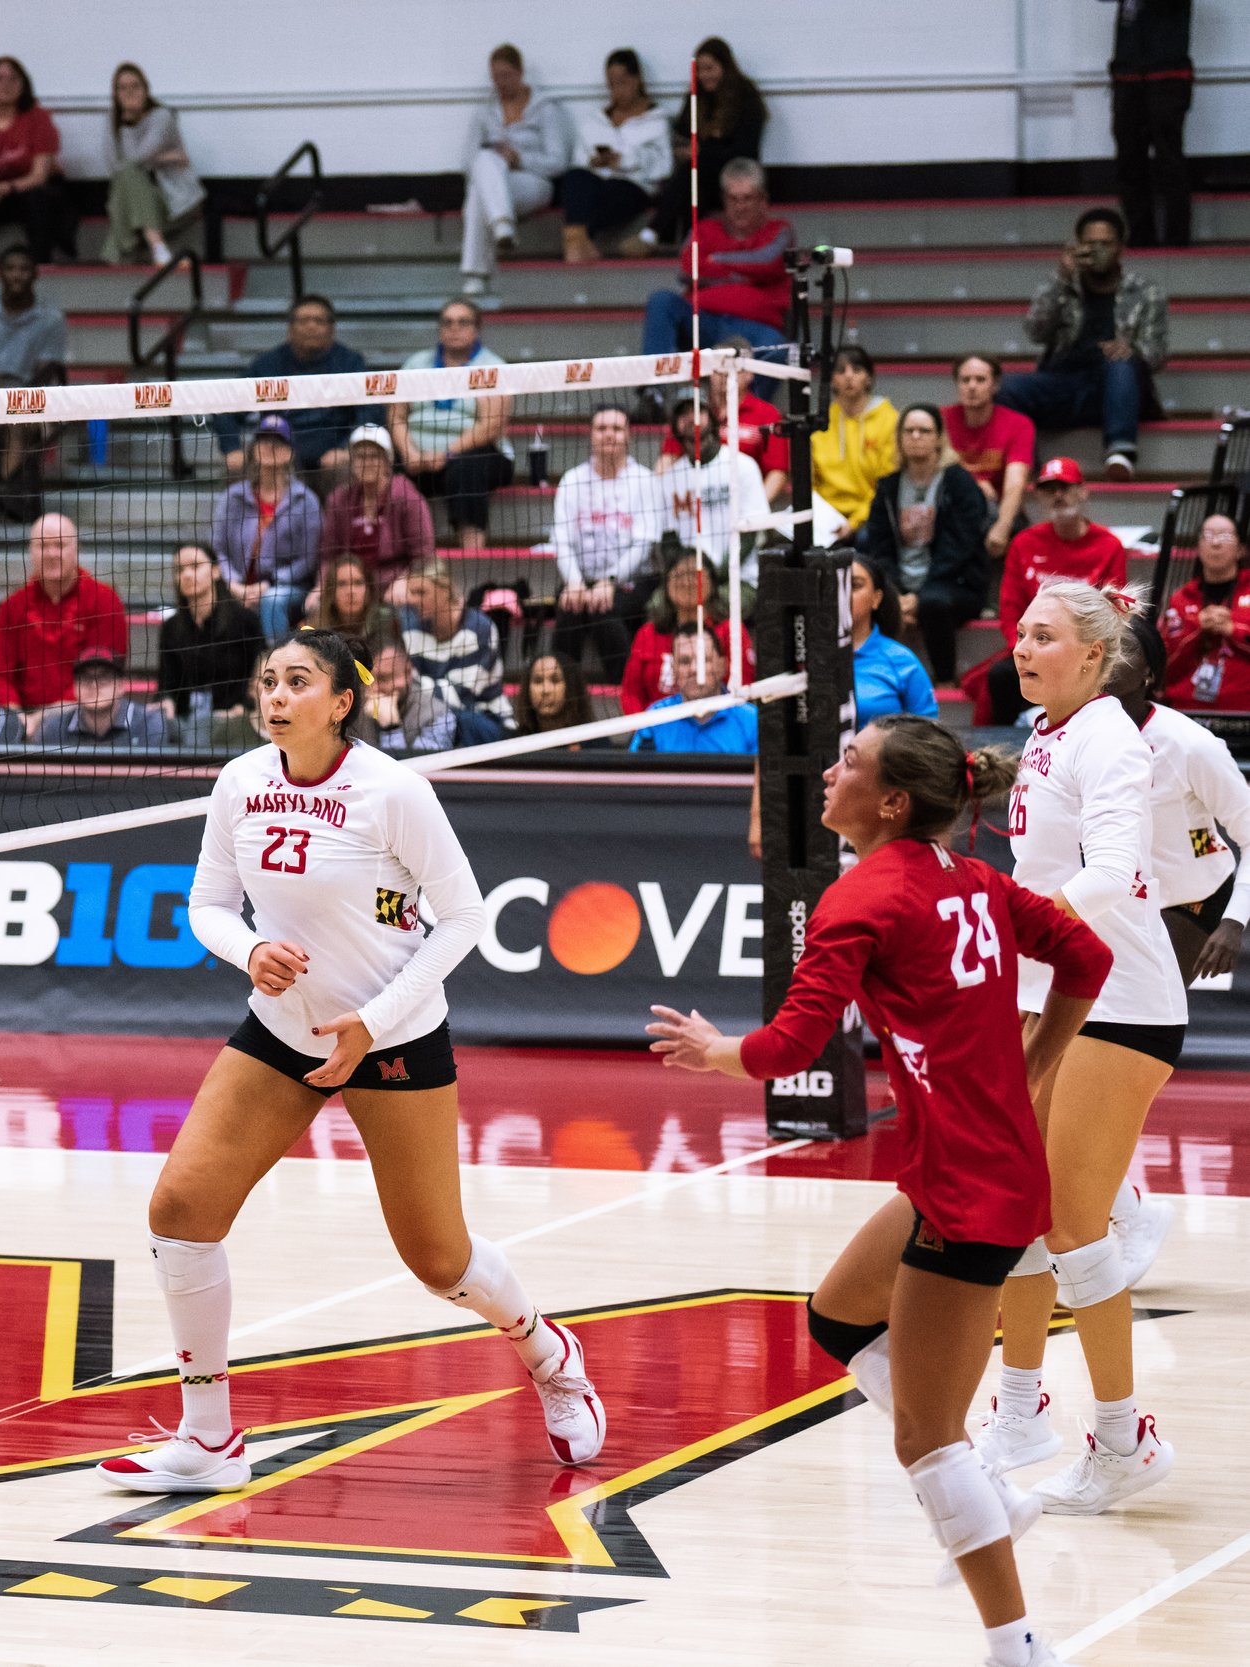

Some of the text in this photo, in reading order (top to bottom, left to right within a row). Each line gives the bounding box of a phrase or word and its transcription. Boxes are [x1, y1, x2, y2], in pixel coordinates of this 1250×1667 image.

[793, 614, 807, 663] sports
[245, 792, 347, 829] MARYLAND
[260, 825, 311, 875] 23
[936, 892, 1002, 989] 24
[377, 1057, 410, 1081] M
[915, 1218, 944, 1252] M
